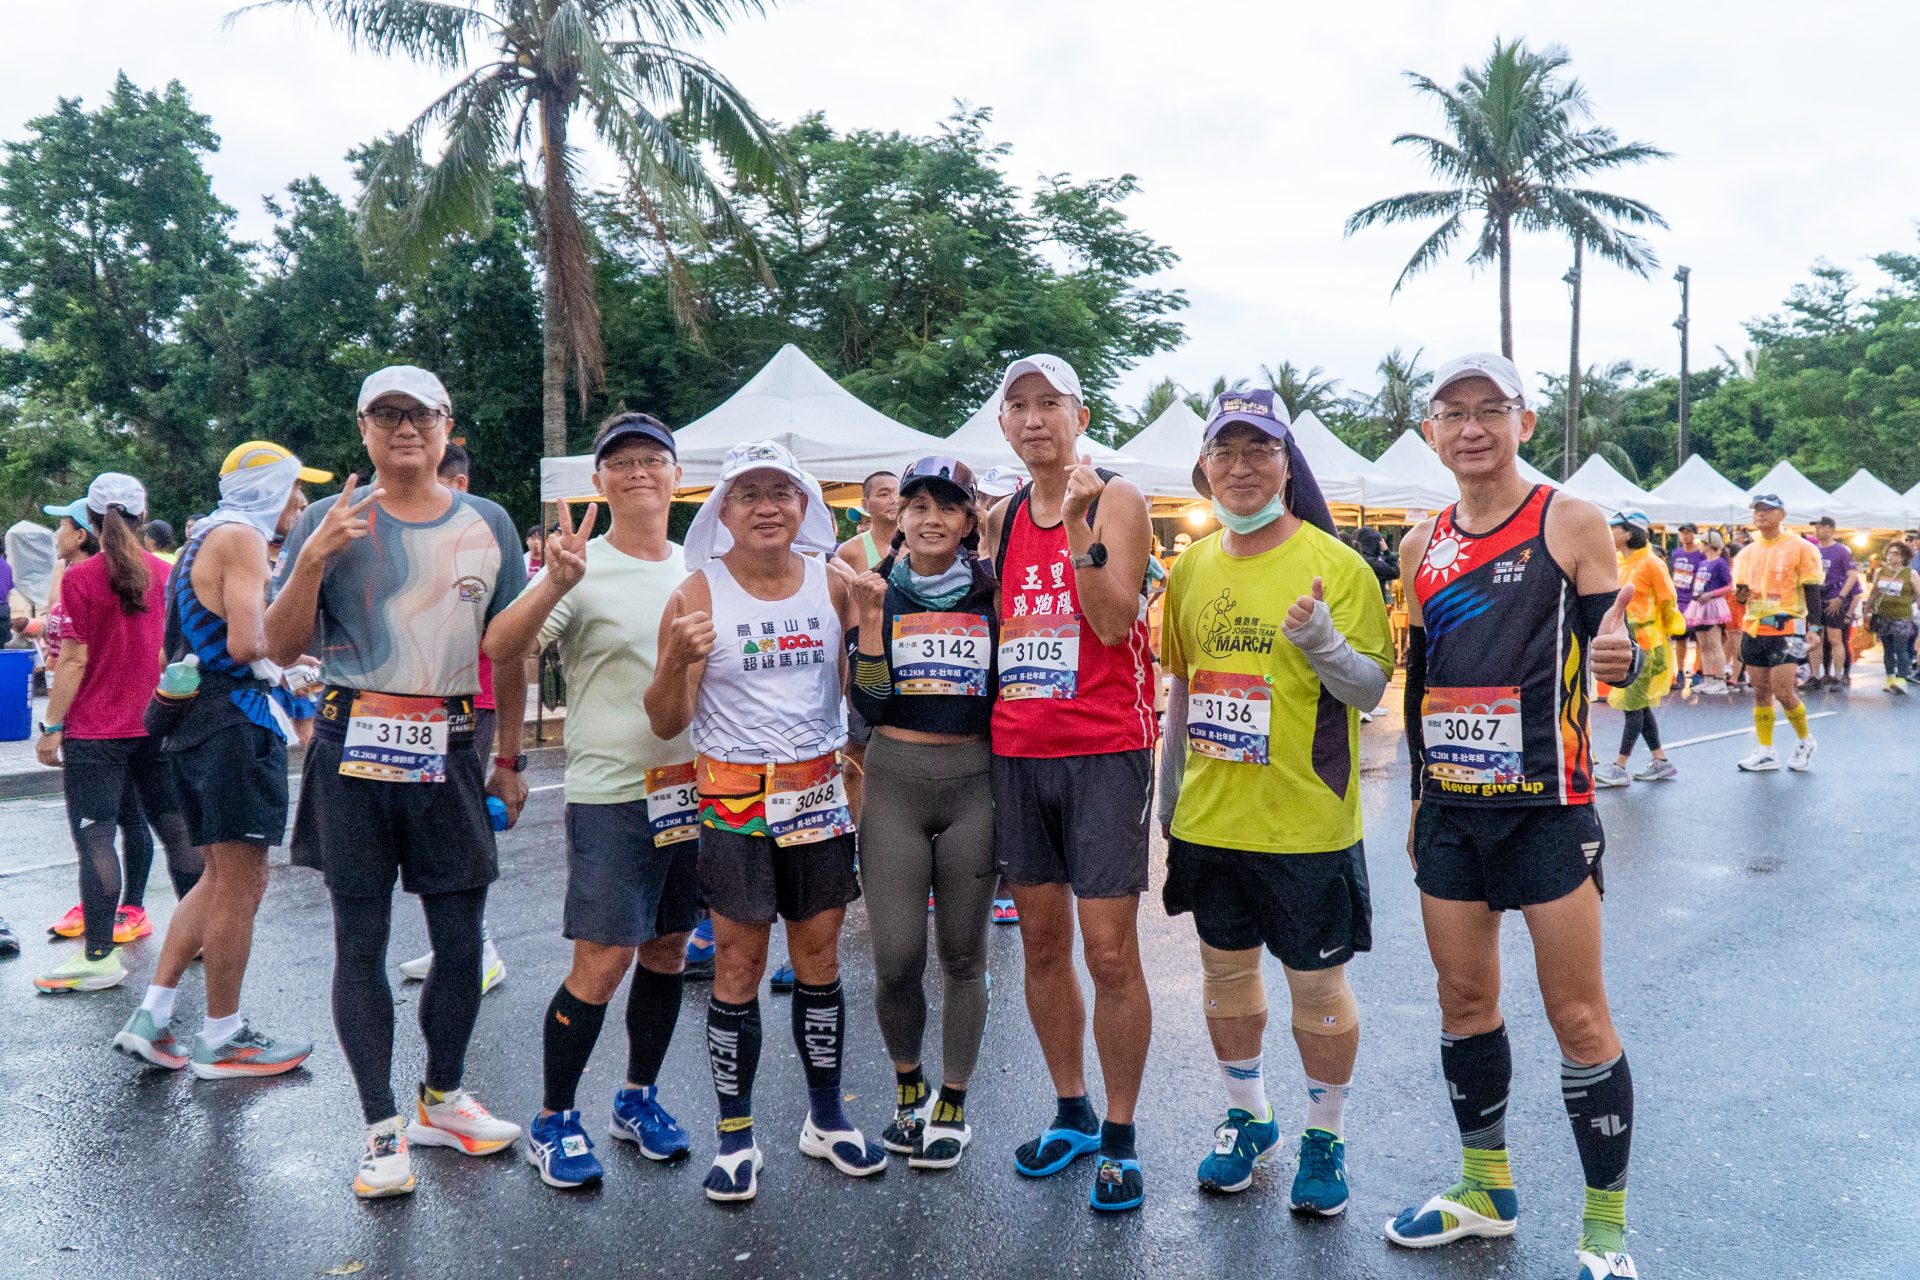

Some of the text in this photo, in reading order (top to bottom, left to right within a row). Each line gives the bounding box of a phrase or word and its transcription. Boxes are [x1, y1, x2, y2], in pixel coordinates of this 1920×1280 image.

[1021, 562, 1066, 590] 玉里
[1013, 590, 1074, 618] 路跑隊
[736, 617, 820, 637] 高雄山城
[1232, 627, 1276, 637] JOGGING TEAM
[922, 639, 975, 658] 3142
[1015, 641, 1062, 662] 3105
[1215, 634, 1273, 654] MARCH
[742, 650, 825, 671] 超級馬拉松
[898, 668, 925, 677] 42.2KM
[1206, 698, 1252, 723] 3136
[377, 723, 432, 745] 3138
[1444, 718, 1501, 740] 3067
[349, 750, 377, 760] 42.2KM
[795, 784, 834, 812] 3068
[1441, 780, 1544, 796] Never give up
[655, 818, 682, 828] 42.2KM
